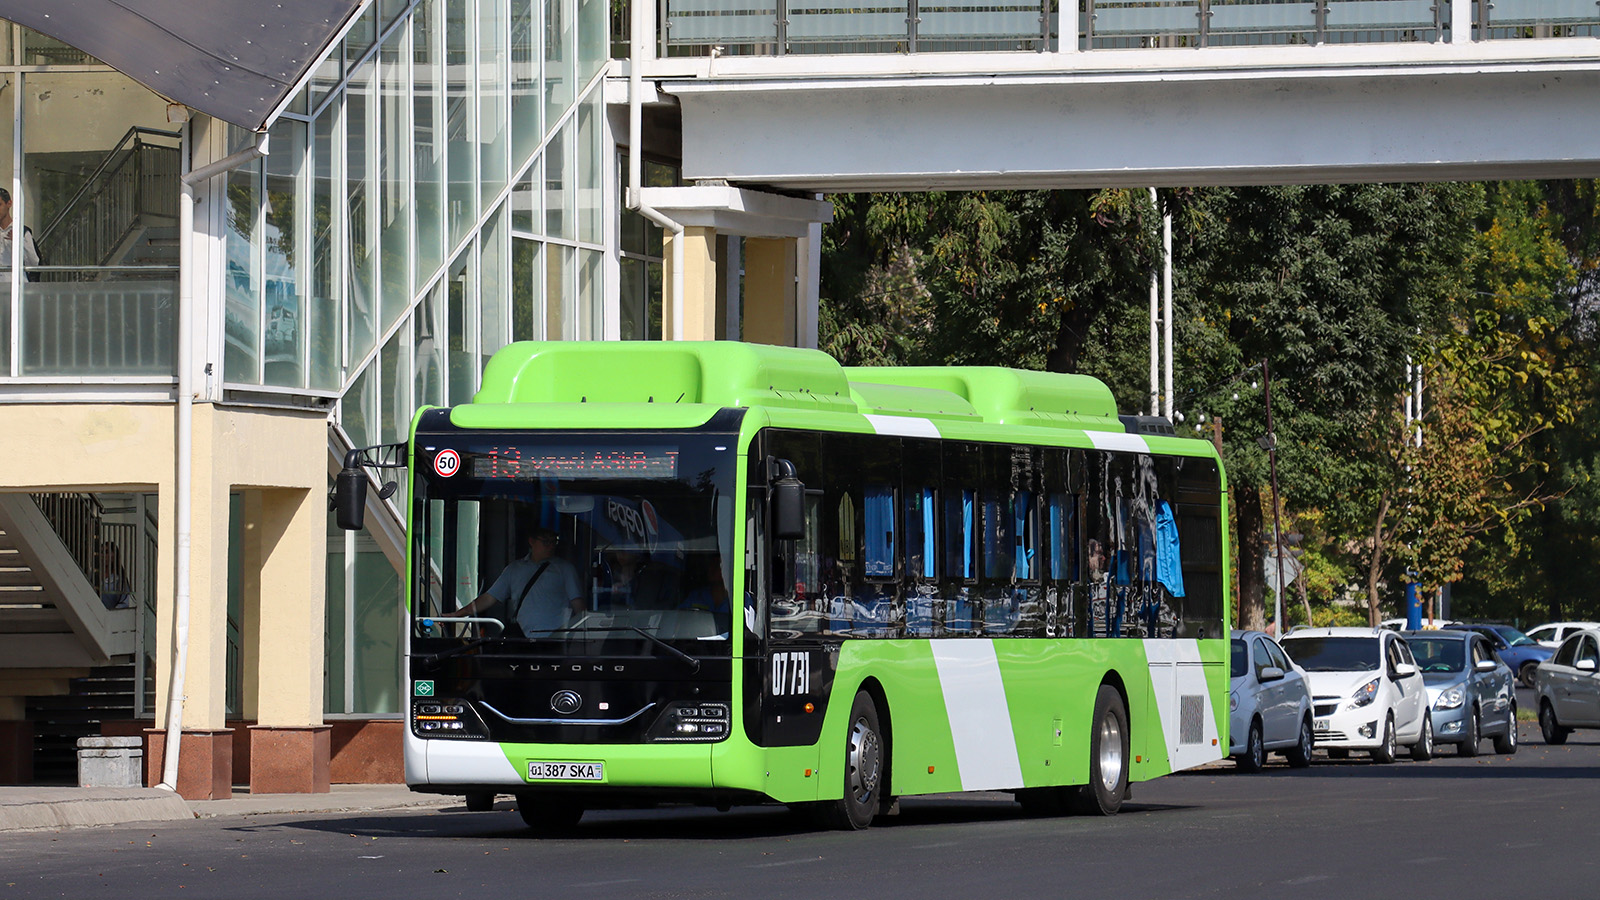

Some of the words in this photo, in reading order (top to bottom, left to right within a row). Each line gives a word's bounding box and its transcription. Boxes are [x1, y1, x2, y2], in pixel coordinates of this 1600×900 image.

[439, 456, 456, 470] 50
[509, 664, 625, 673] YUTONG
[772, 652, 788, 696] 07
[790, 651, 810, 696] 731
[530, 765, 543, 776] 01
[544, 764, 567, 777] 387
[569, 764, 595, 778] SKA
